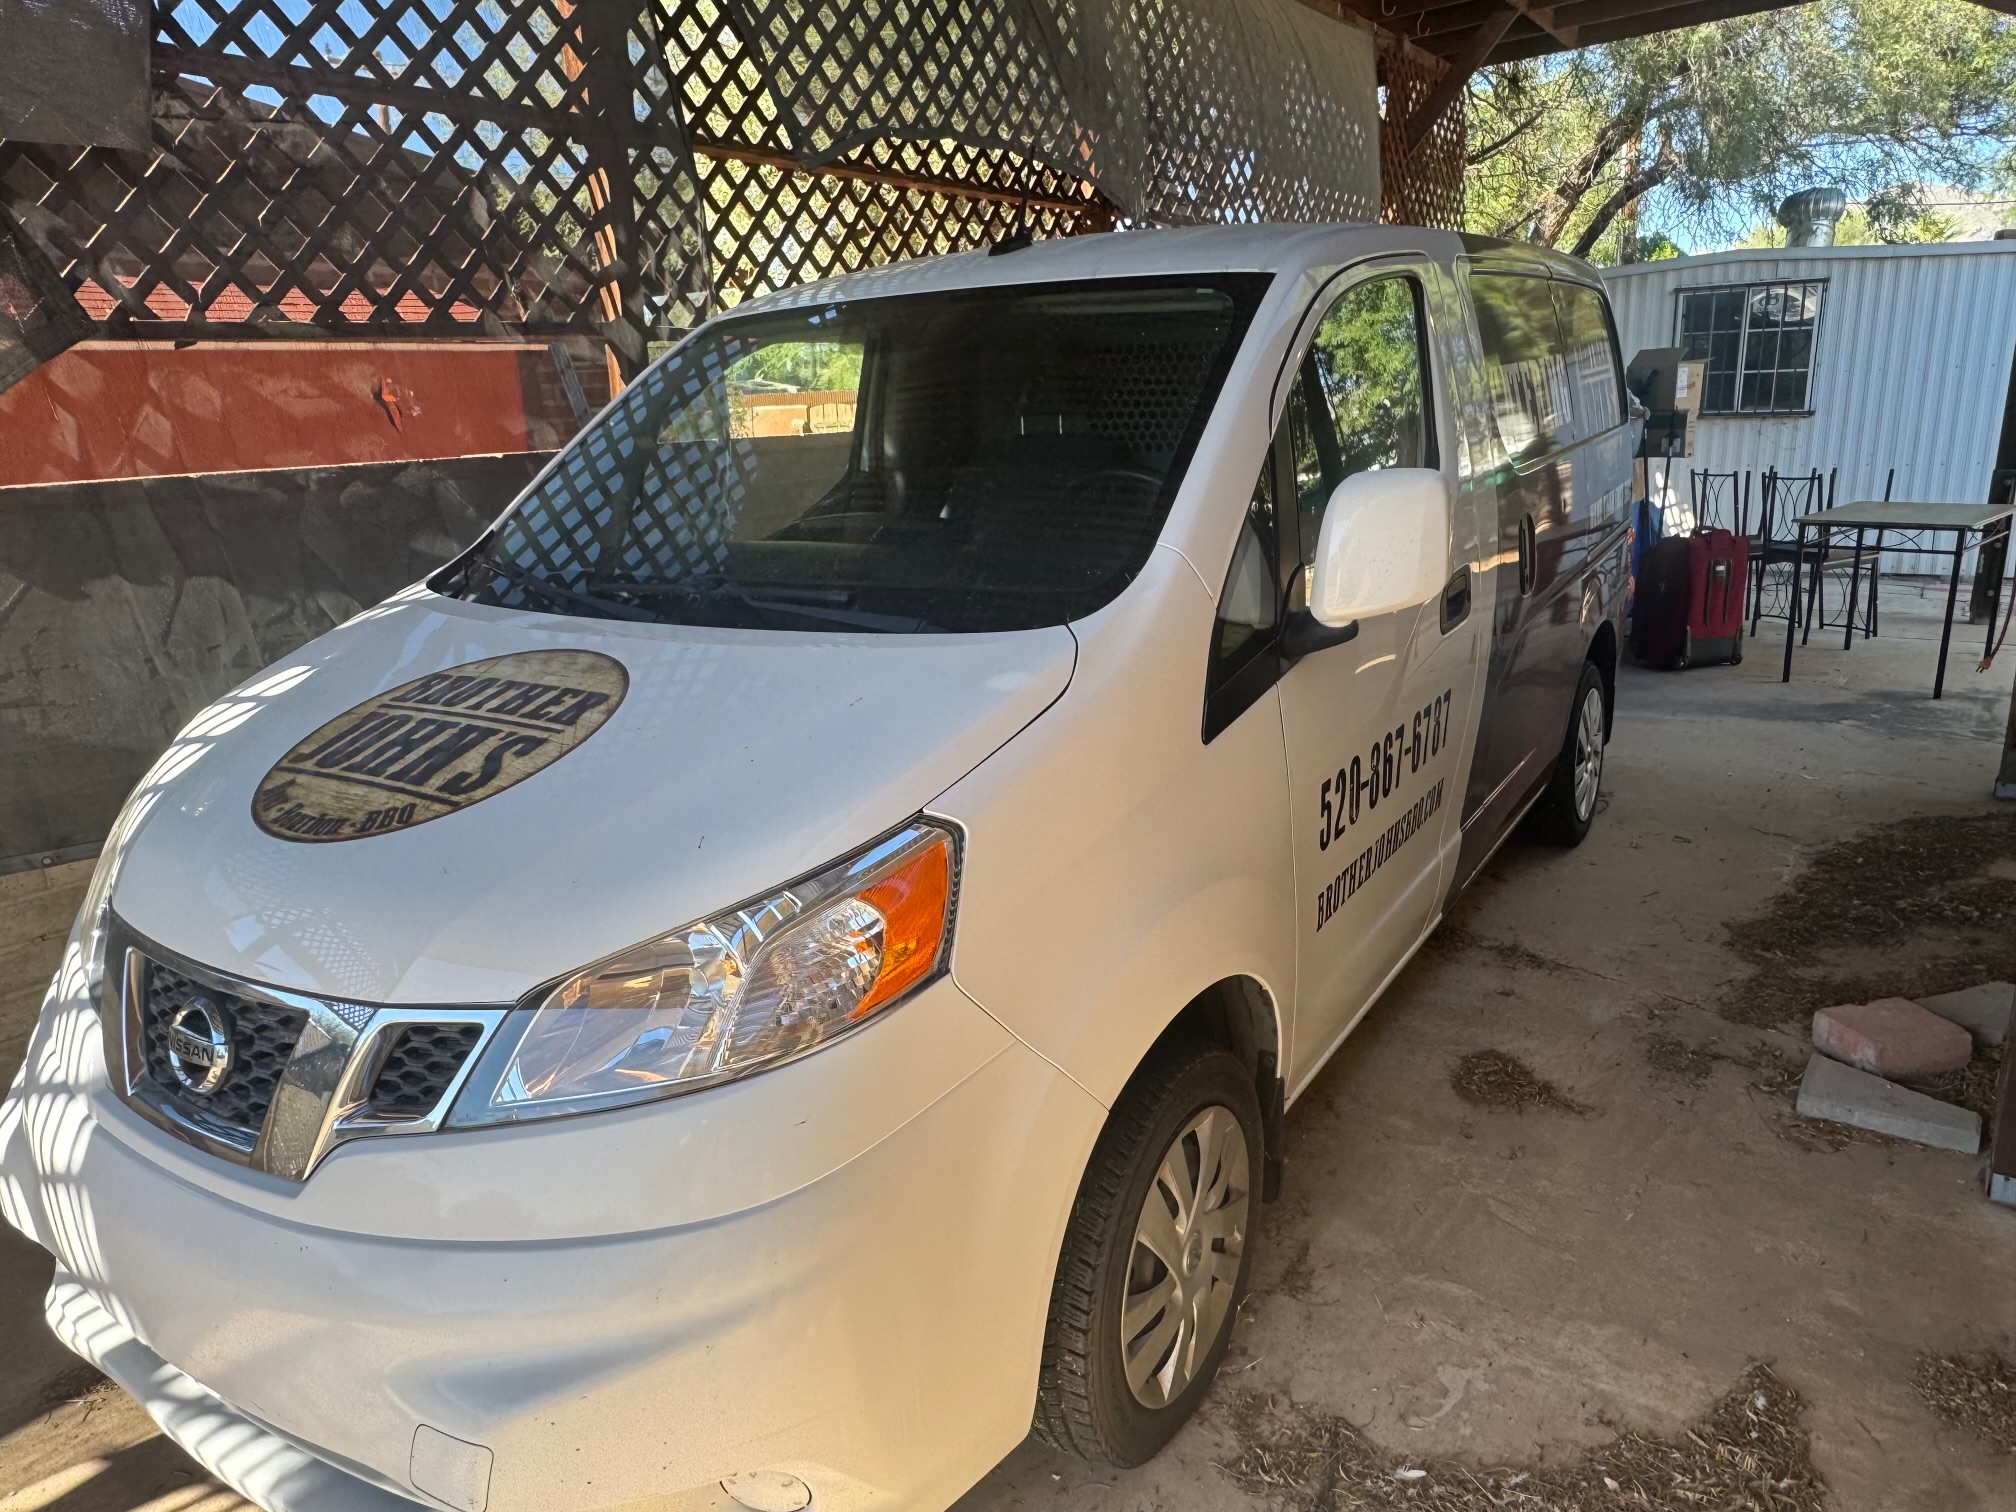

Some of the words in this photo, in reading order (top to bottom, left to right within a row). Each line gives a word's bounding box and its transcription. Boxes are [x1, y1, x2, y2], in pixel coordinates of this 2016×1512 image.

[391, 673, 611, 726] BROTHER
[287, 712, 550, 796] JOHN'S
[1319, 688, 1452, 852] 520-867-6787
[354, 803, 418, 833] BBQ
[1316, 777, 1446, 932] BROTHERJOHNSBBQ.COM
[169, 1032, 215, 1063] NISSAN
